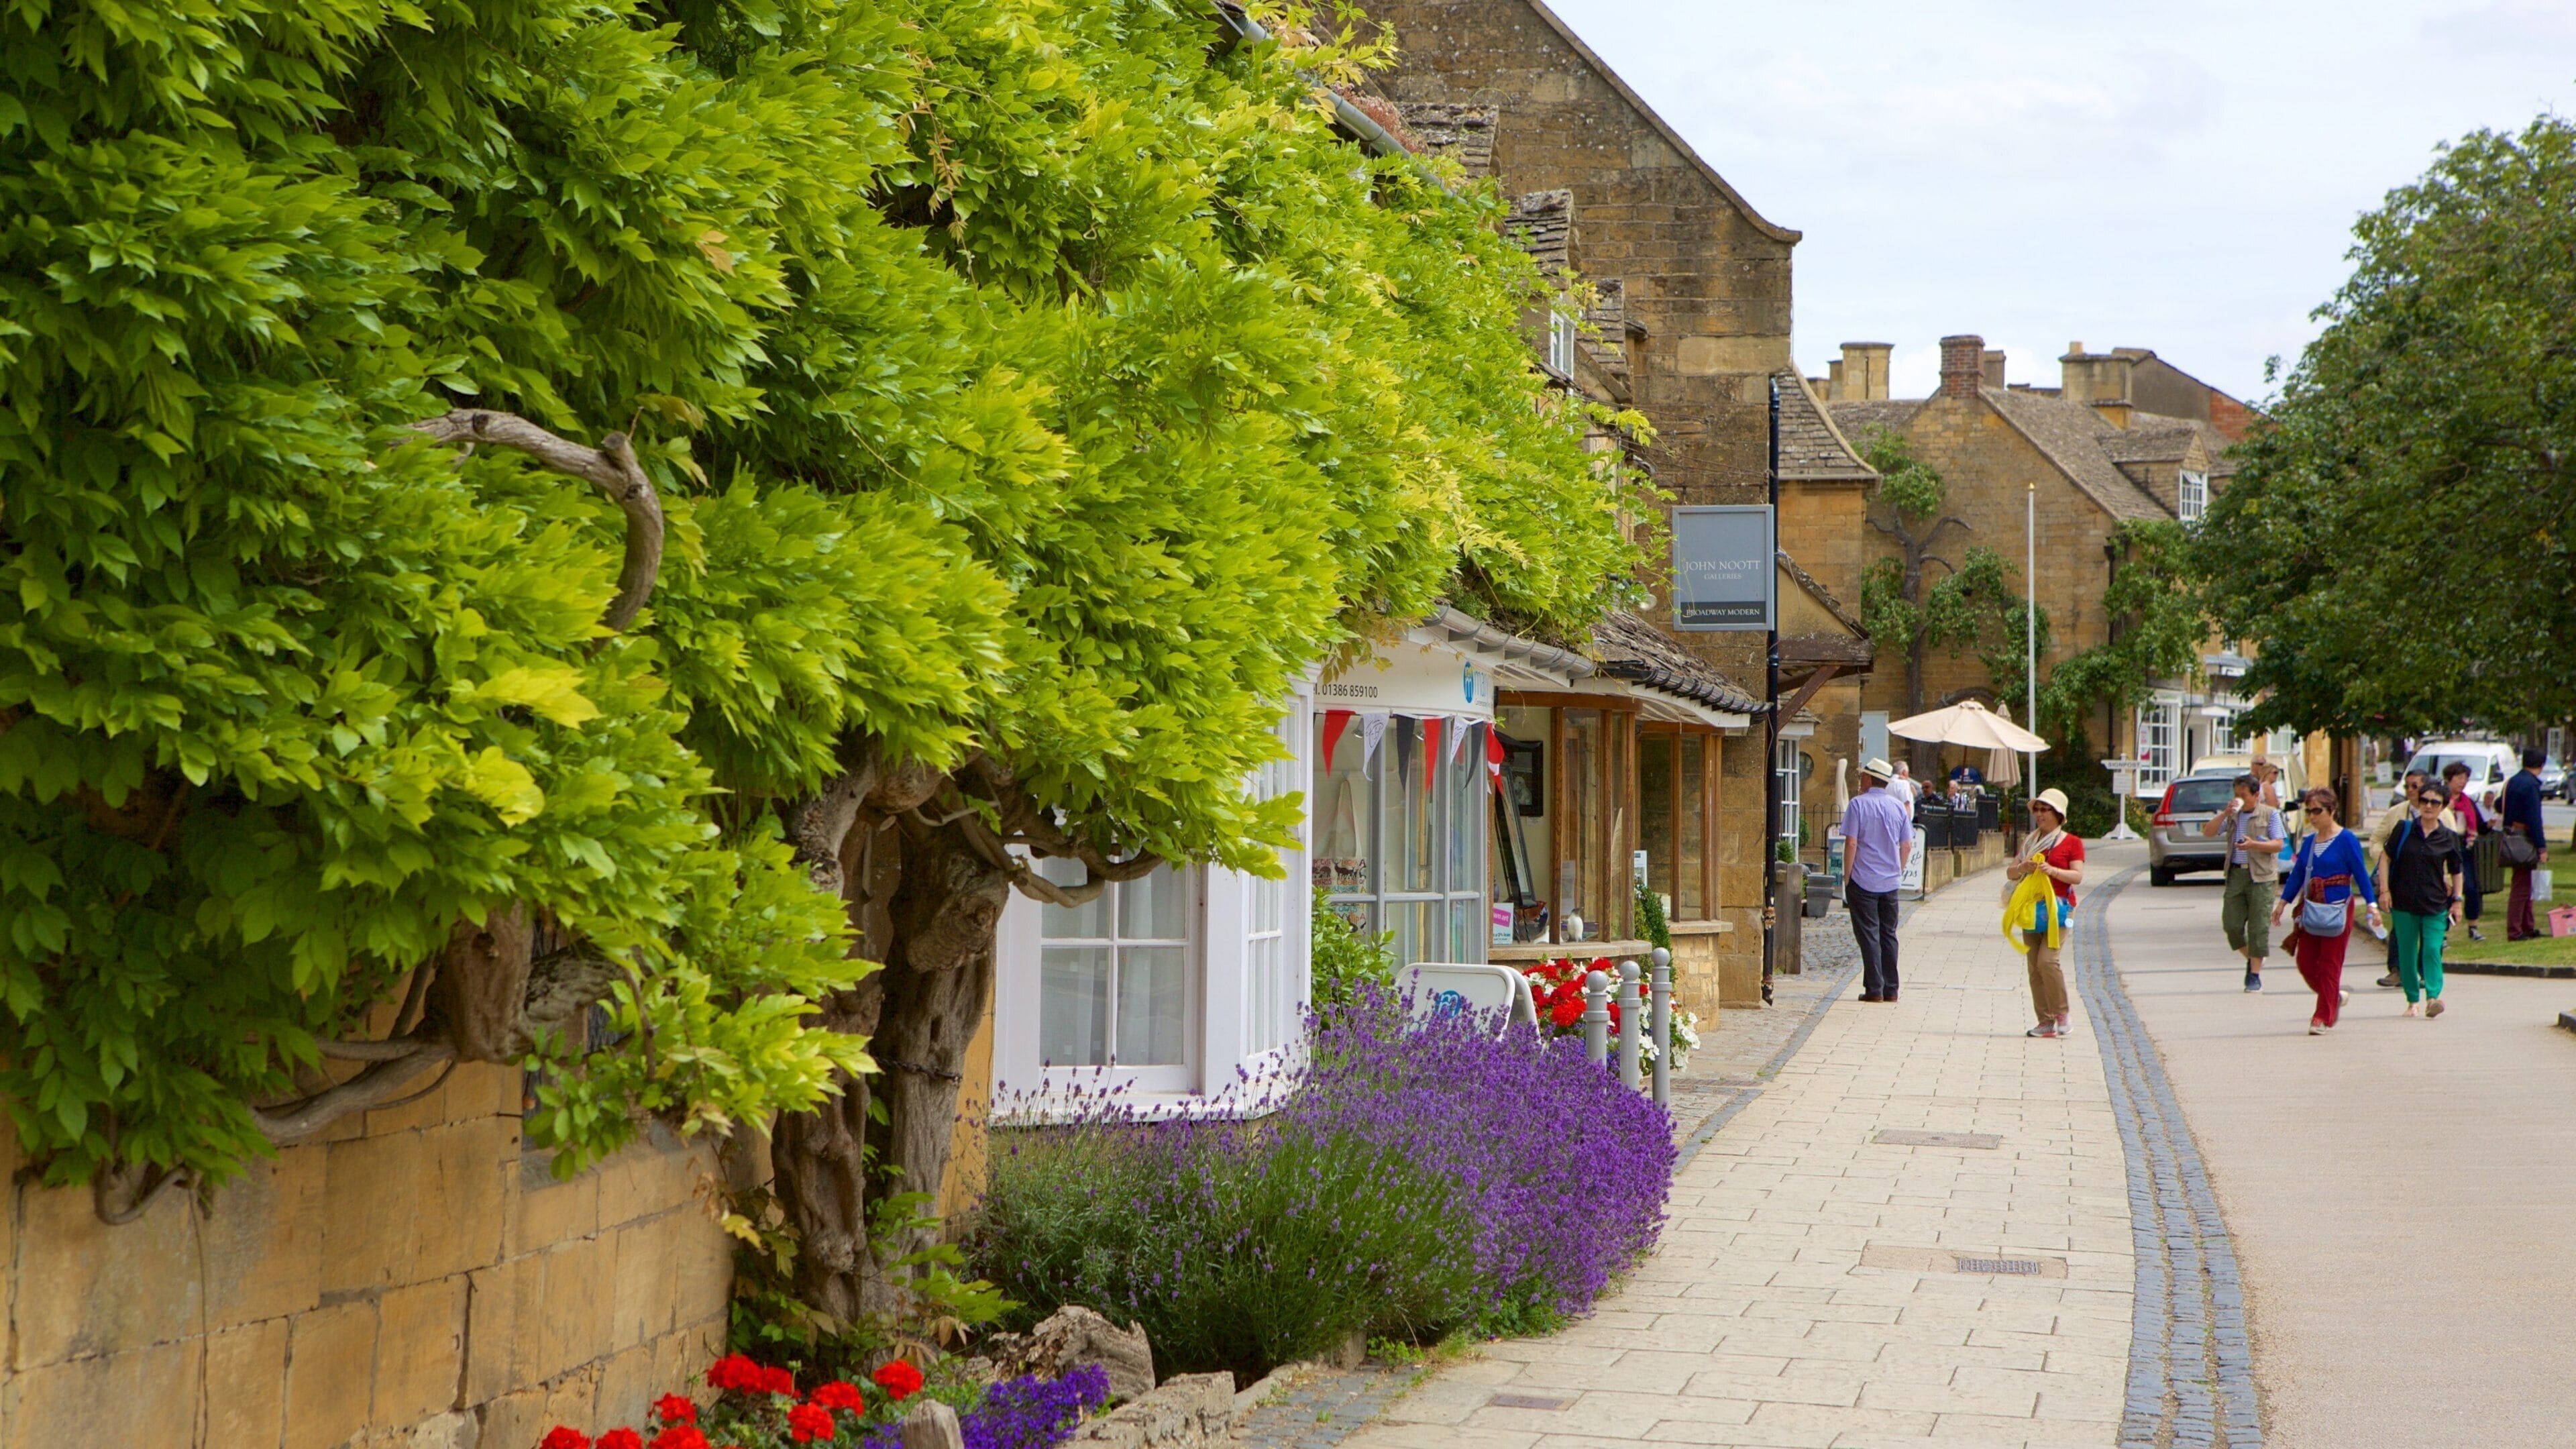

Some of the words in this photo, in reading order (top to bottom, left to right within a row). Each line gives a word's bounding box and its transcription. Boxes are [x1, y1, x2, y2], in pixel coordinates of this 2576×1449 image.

[1685, 561, 1715, 572] JOHN
[1719, 560, 1760, 570] NOOTT
[1322, 684, 1348, 696] 01386
[1349, 684, 1378, 698] 859100
